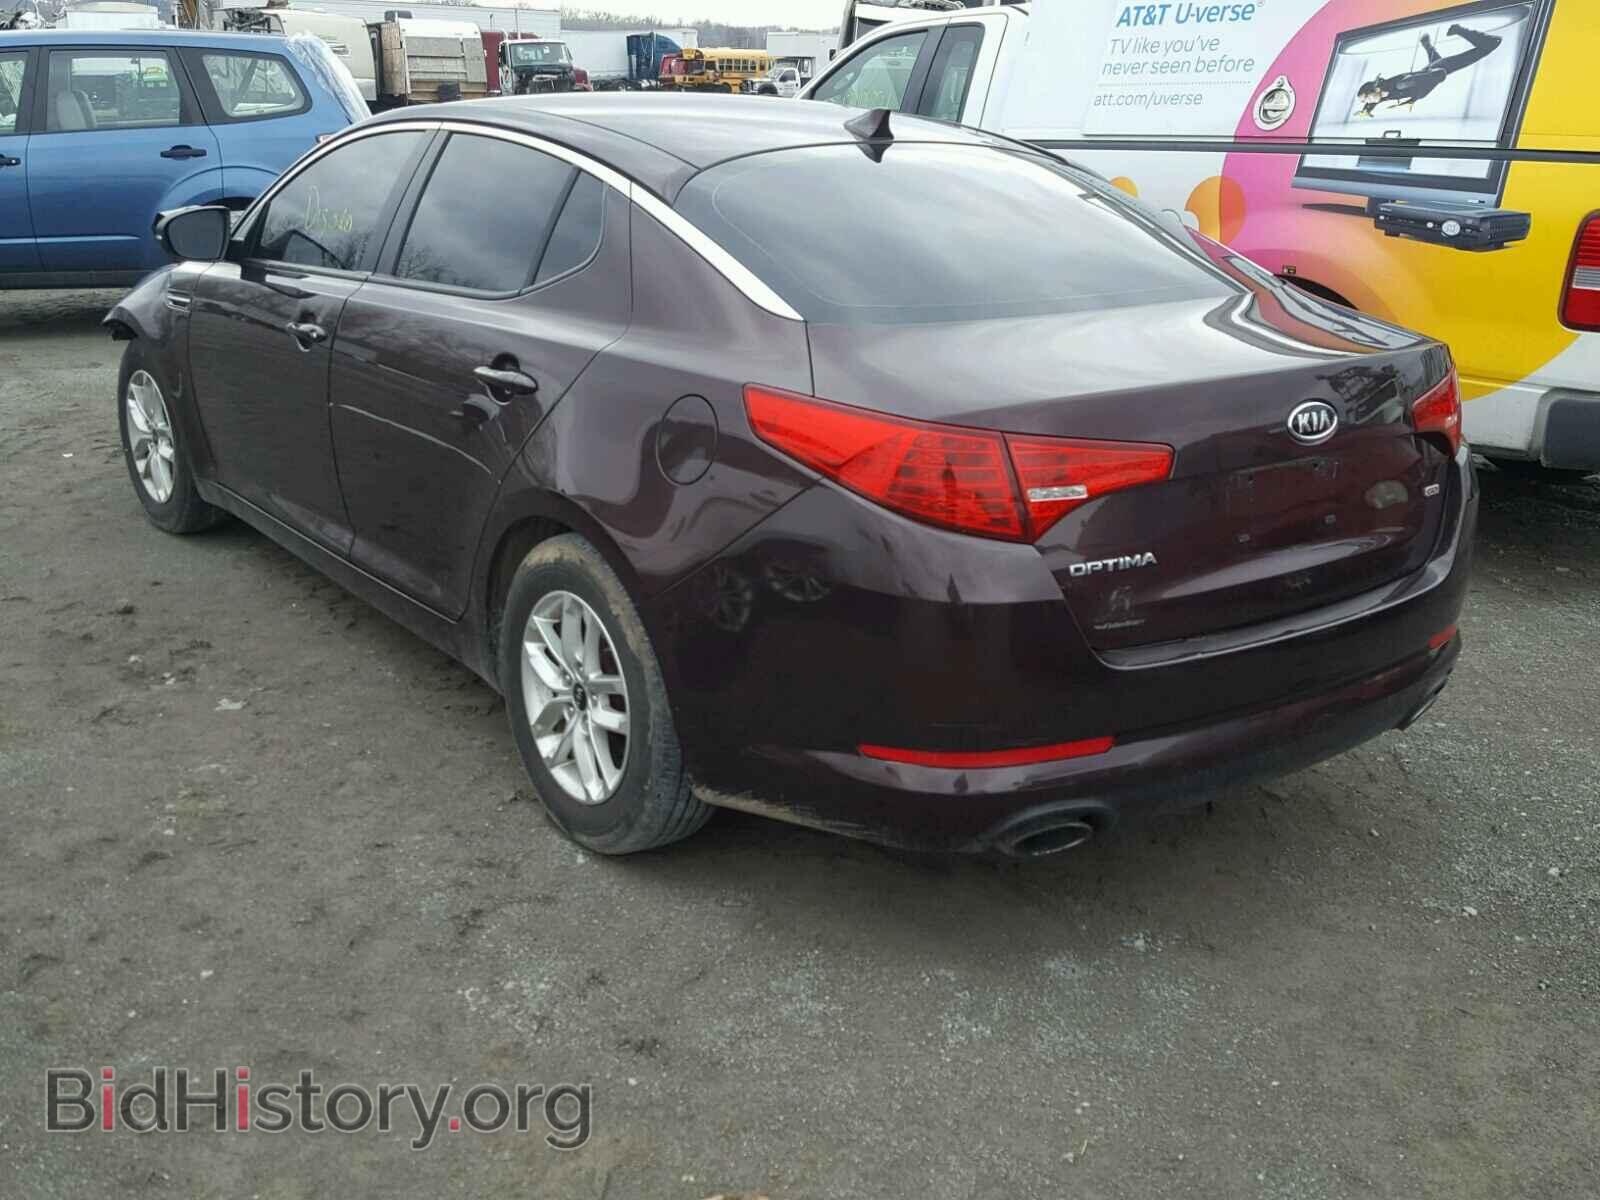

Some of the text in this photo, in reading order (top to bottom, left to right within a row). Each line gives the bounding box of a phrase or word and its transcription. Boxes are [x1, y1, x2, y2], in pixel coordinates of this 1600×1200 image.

[1116, 4, 1171, 27] AT&T
[1110, 36, 1220, 56] TV like you've
[1102, 55, 1255, 76] never seen before
[1093, 92, 1203, 109] att.com/uverse
[1297, 409, 1332, 433] KIA
[1069, 552, 1158, 577] OPTIMA
